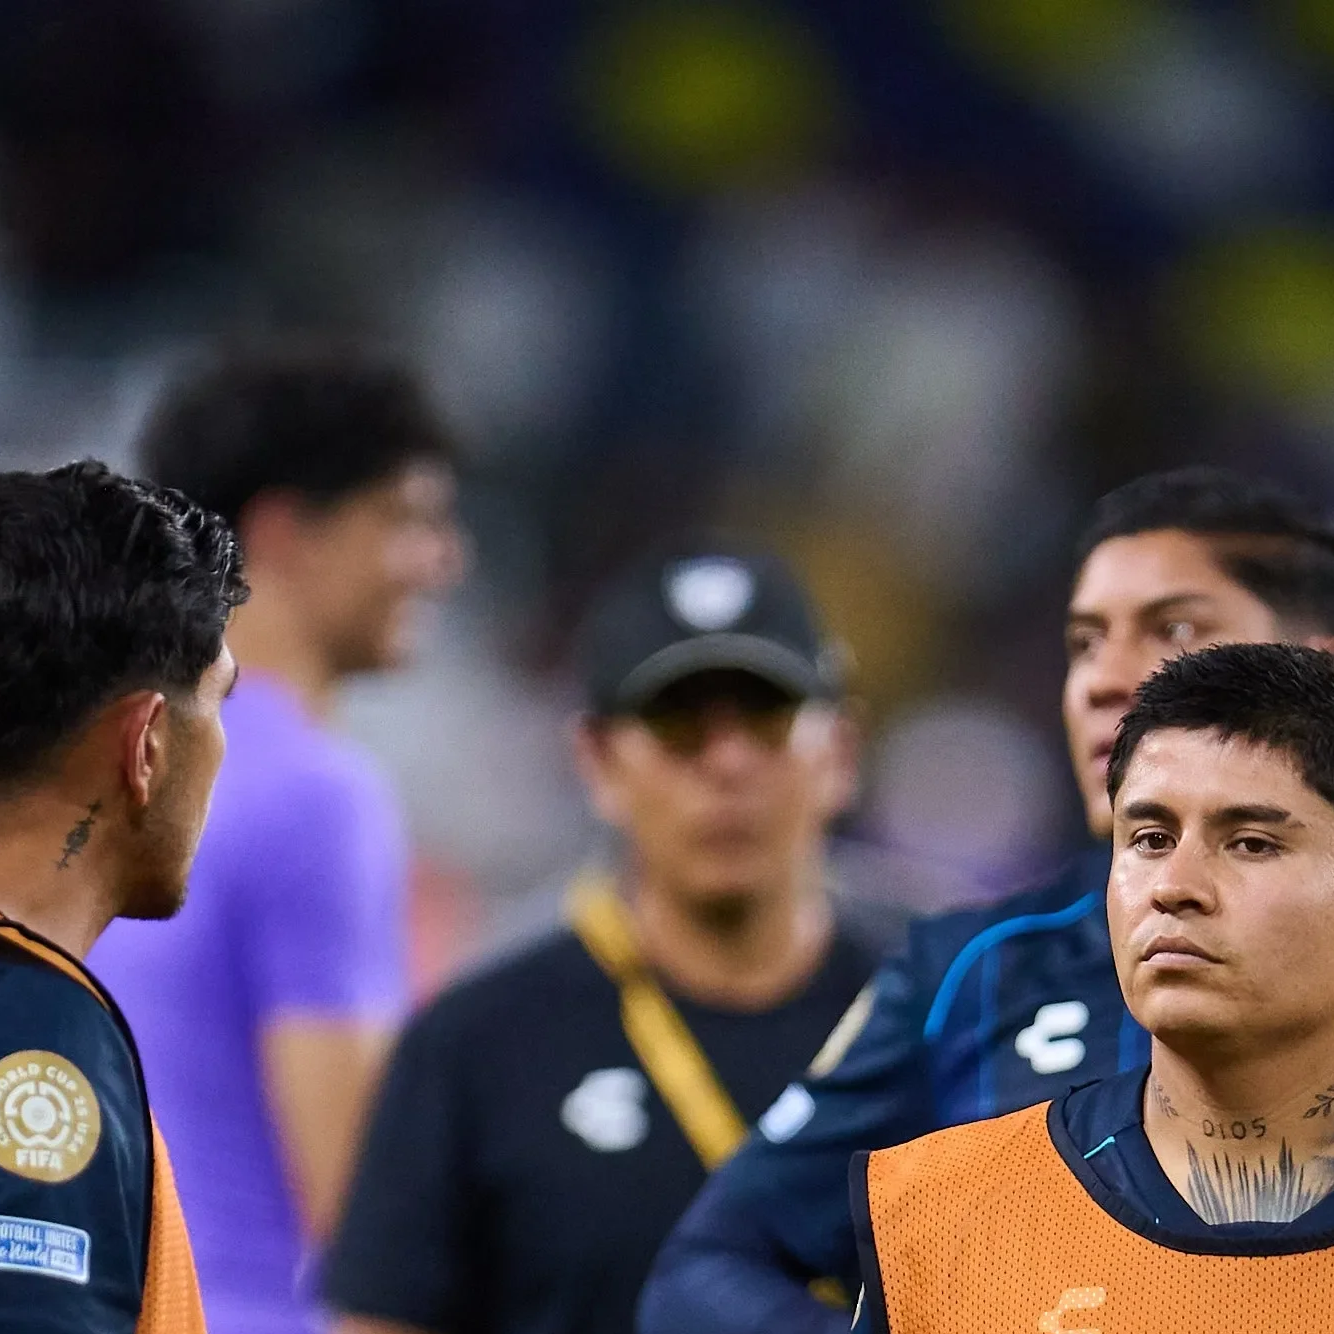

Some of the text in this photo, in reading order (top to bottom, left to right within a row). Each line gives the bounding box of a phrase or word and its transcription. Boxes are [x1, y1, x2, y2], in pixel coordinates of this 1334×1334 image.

[46, 1065, 78, 1092] CUP
[1202, 1117, 1267, 1141] DIOS
[16, 1148, 63, 1171] FIFA
